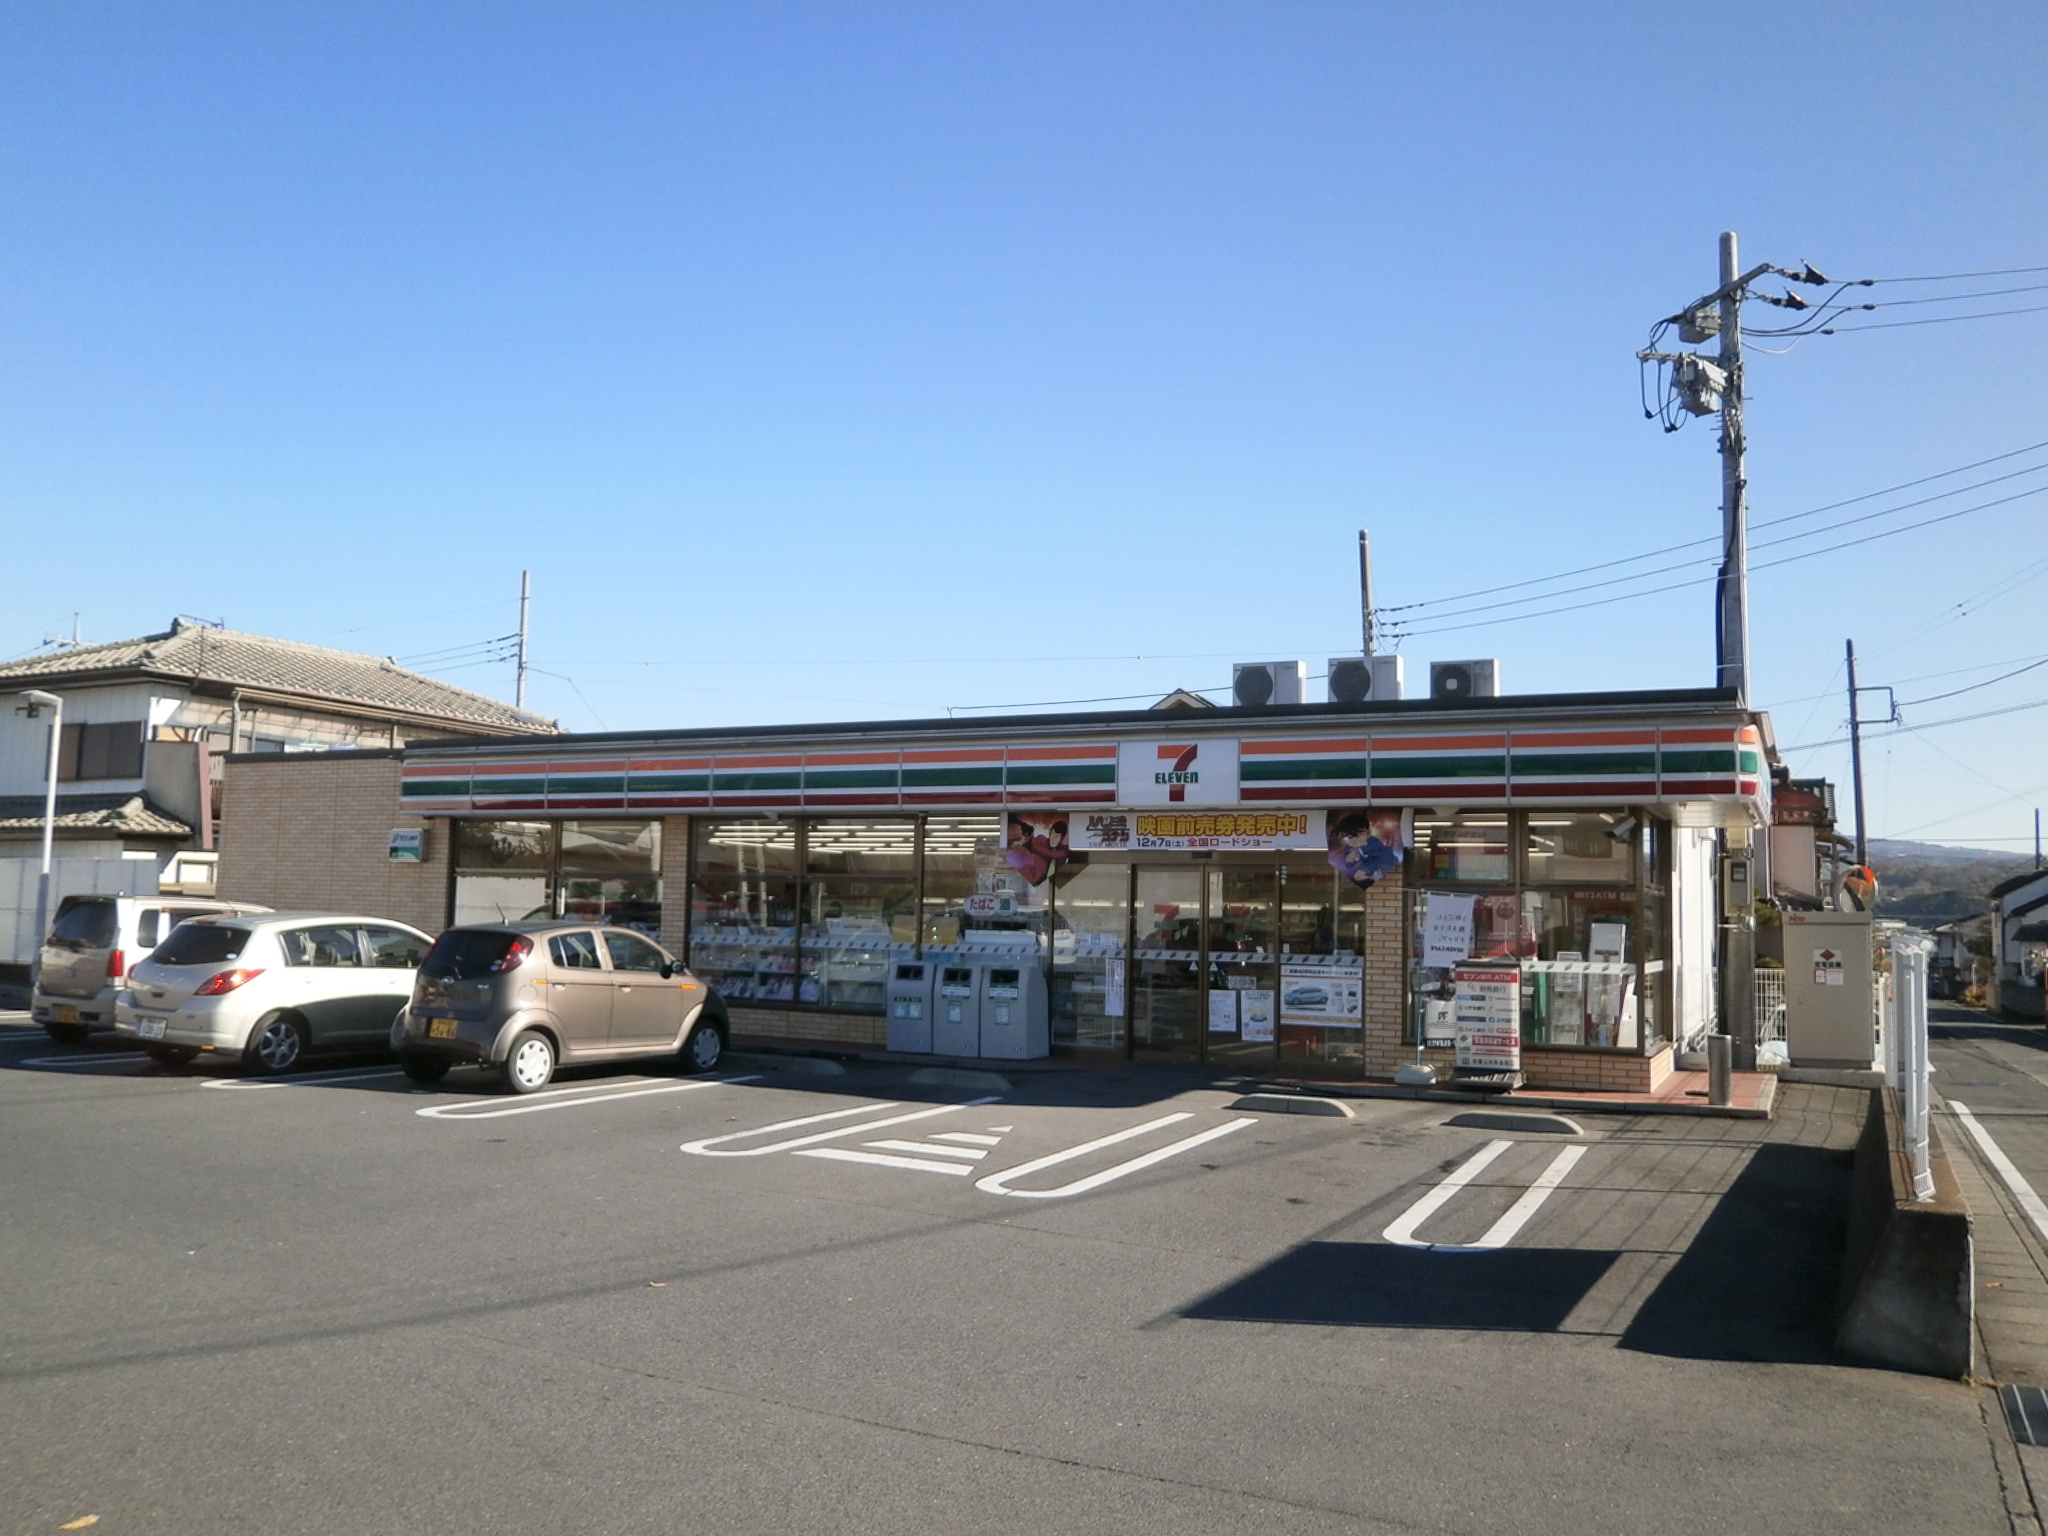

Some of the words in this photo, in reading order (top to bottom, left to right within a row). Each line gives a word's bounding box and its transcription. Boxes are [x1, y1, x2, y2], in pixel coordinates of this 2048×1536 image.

[1187, 837, 1272, 847] 全国ロードショー
[969, 898, 995, 910] たばこ
